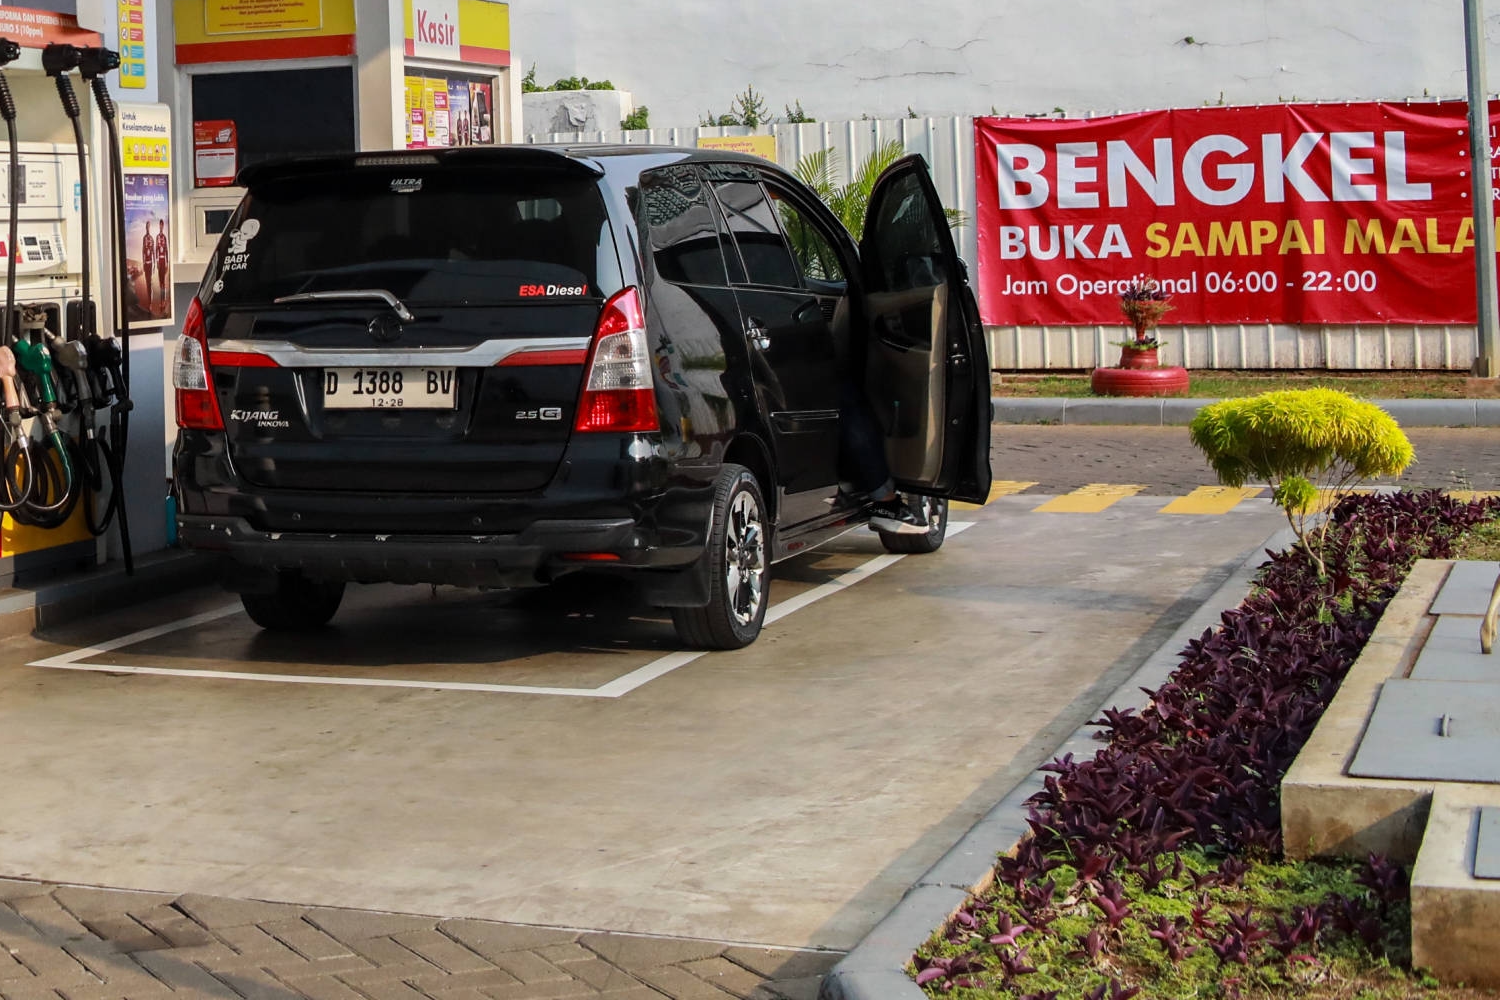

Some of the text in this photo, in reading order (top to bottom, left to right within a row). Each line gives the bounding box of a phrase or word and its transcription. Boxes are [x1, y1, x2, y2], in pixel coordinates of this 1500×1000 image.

[23, 13, 35, 24] DAN
[0, 22, 14, 34] EURO
[417, 9, 454, 46] Kasir
[122, 112, 136, 120] Untuk
[122, 123, 166, 132] Keselamatan Anda
[996, 131, 1432, 209] BENGKEL
[391, 178, 423, 186] ULTRA
[1000, 217, 1500, 260] BUKA SAMPAI MALA
[224, 253, 250, 264] BABY
[231, 262, 247, 271] CAR
[1001, 275, 1048, 296] Jam
[1205, 271, 1278, 293] 06:00
[1302, 270, 1377, 292] 22:00
[326, 370, 453, 395] D 1388 BV
[542, 408, 560, 420] G
